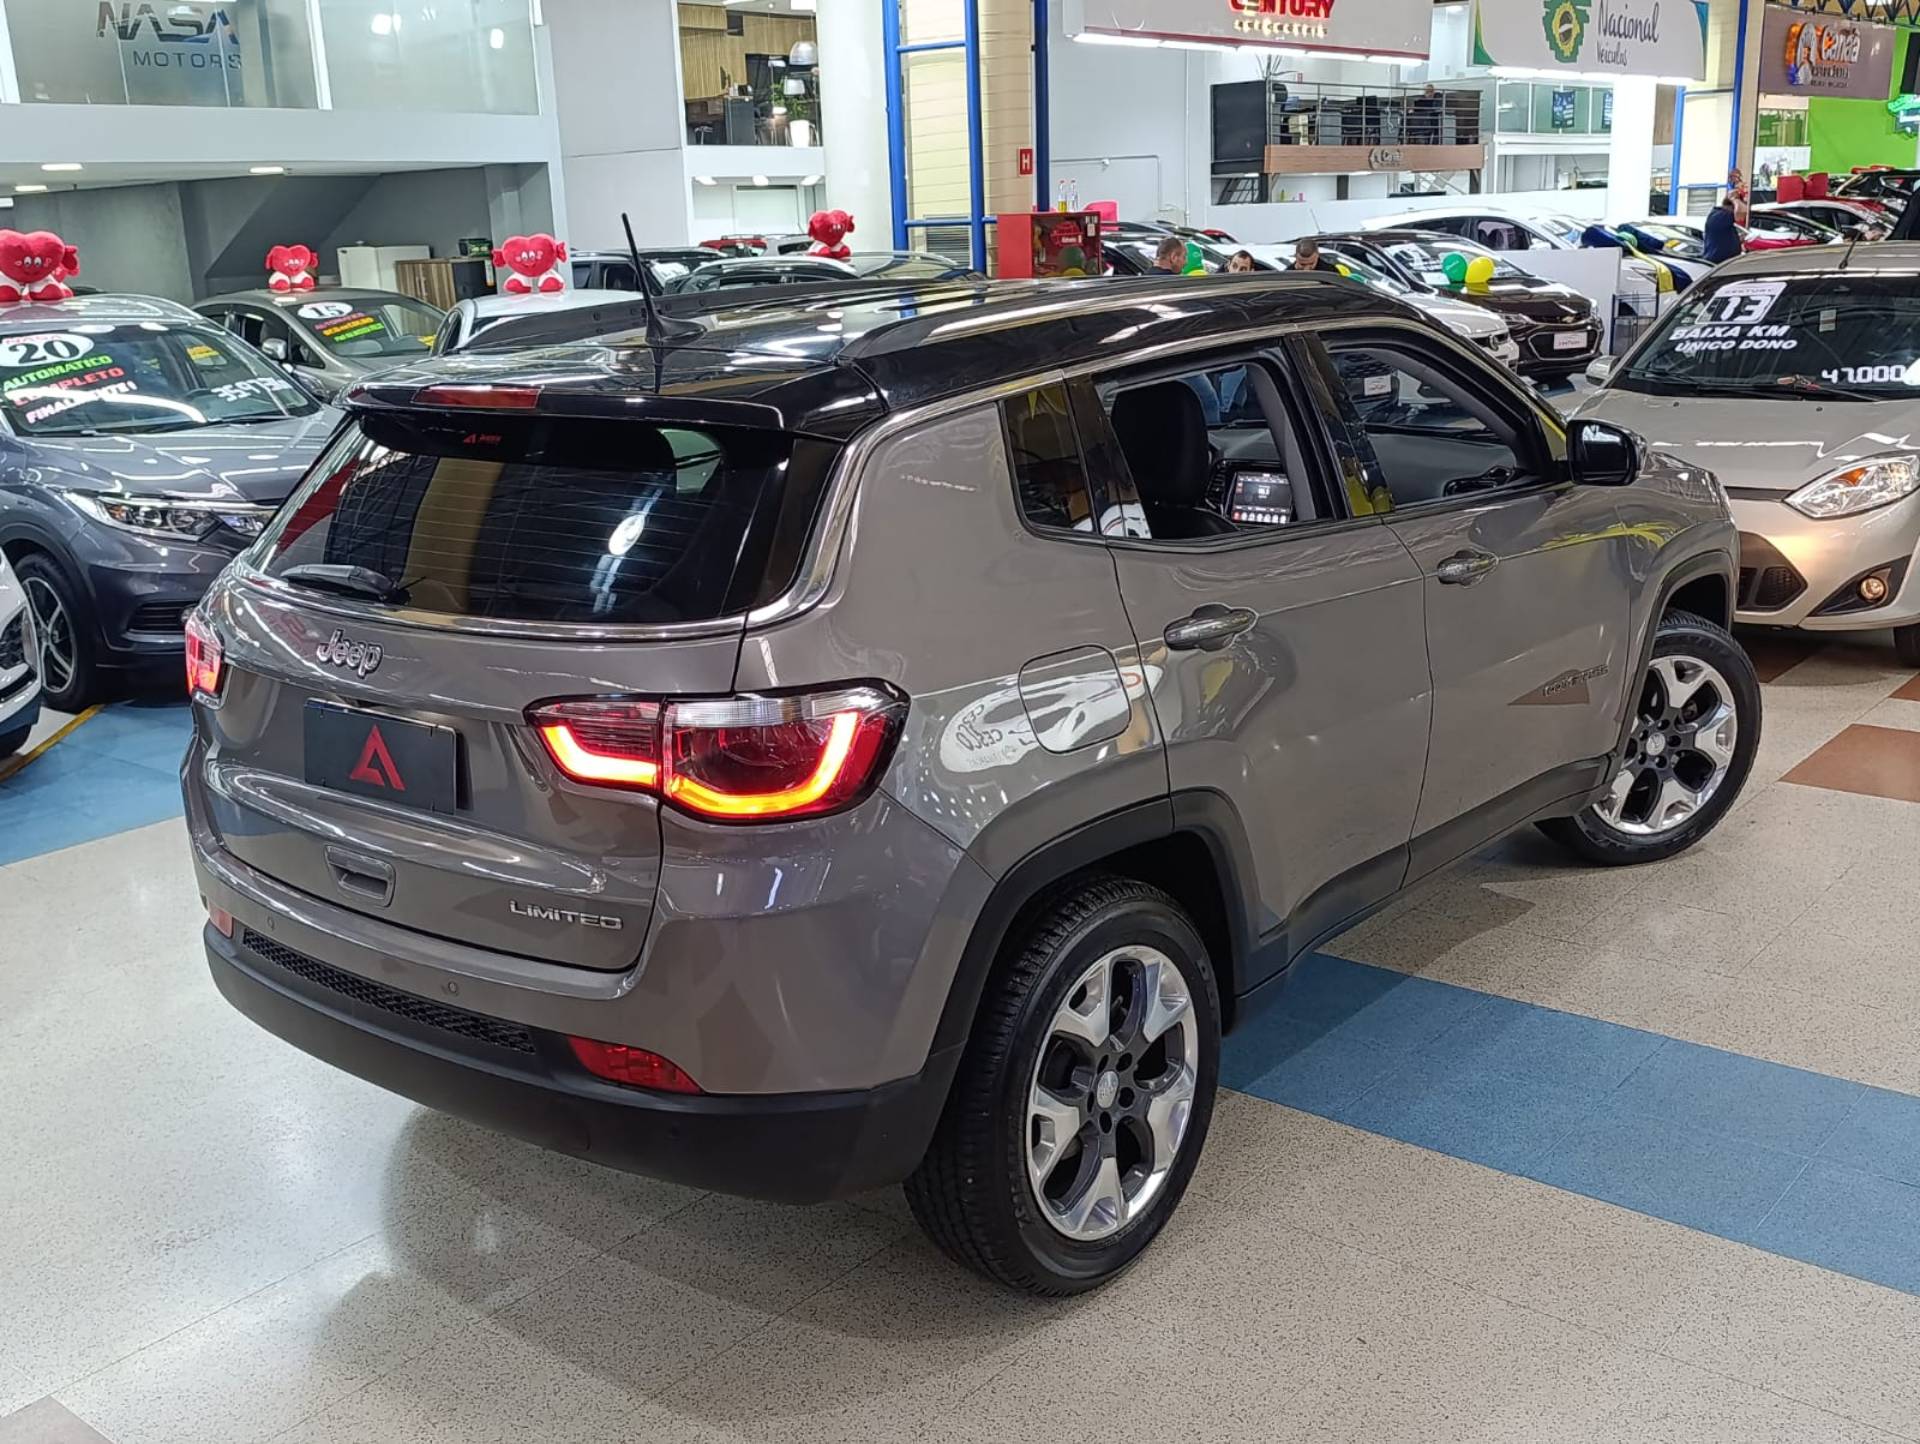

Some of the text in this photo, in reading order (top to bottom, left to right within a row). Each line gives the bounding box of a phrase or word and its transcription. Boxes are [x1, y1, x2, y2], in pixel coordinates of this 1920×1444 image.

[1598, 0, 1660, 43] Nacional
[133, 51, 242, 70] MOTORS
[1720, 295, 1772, 321] 13
[1669, 325, 1791, 341] BAIXA KM
[1738, 340, 1798, 350] DONO
[8, 340, 80, 364] 20
[316, 630, 384, 679] Jeep
[509, 900, 622, 930] LIMITED
